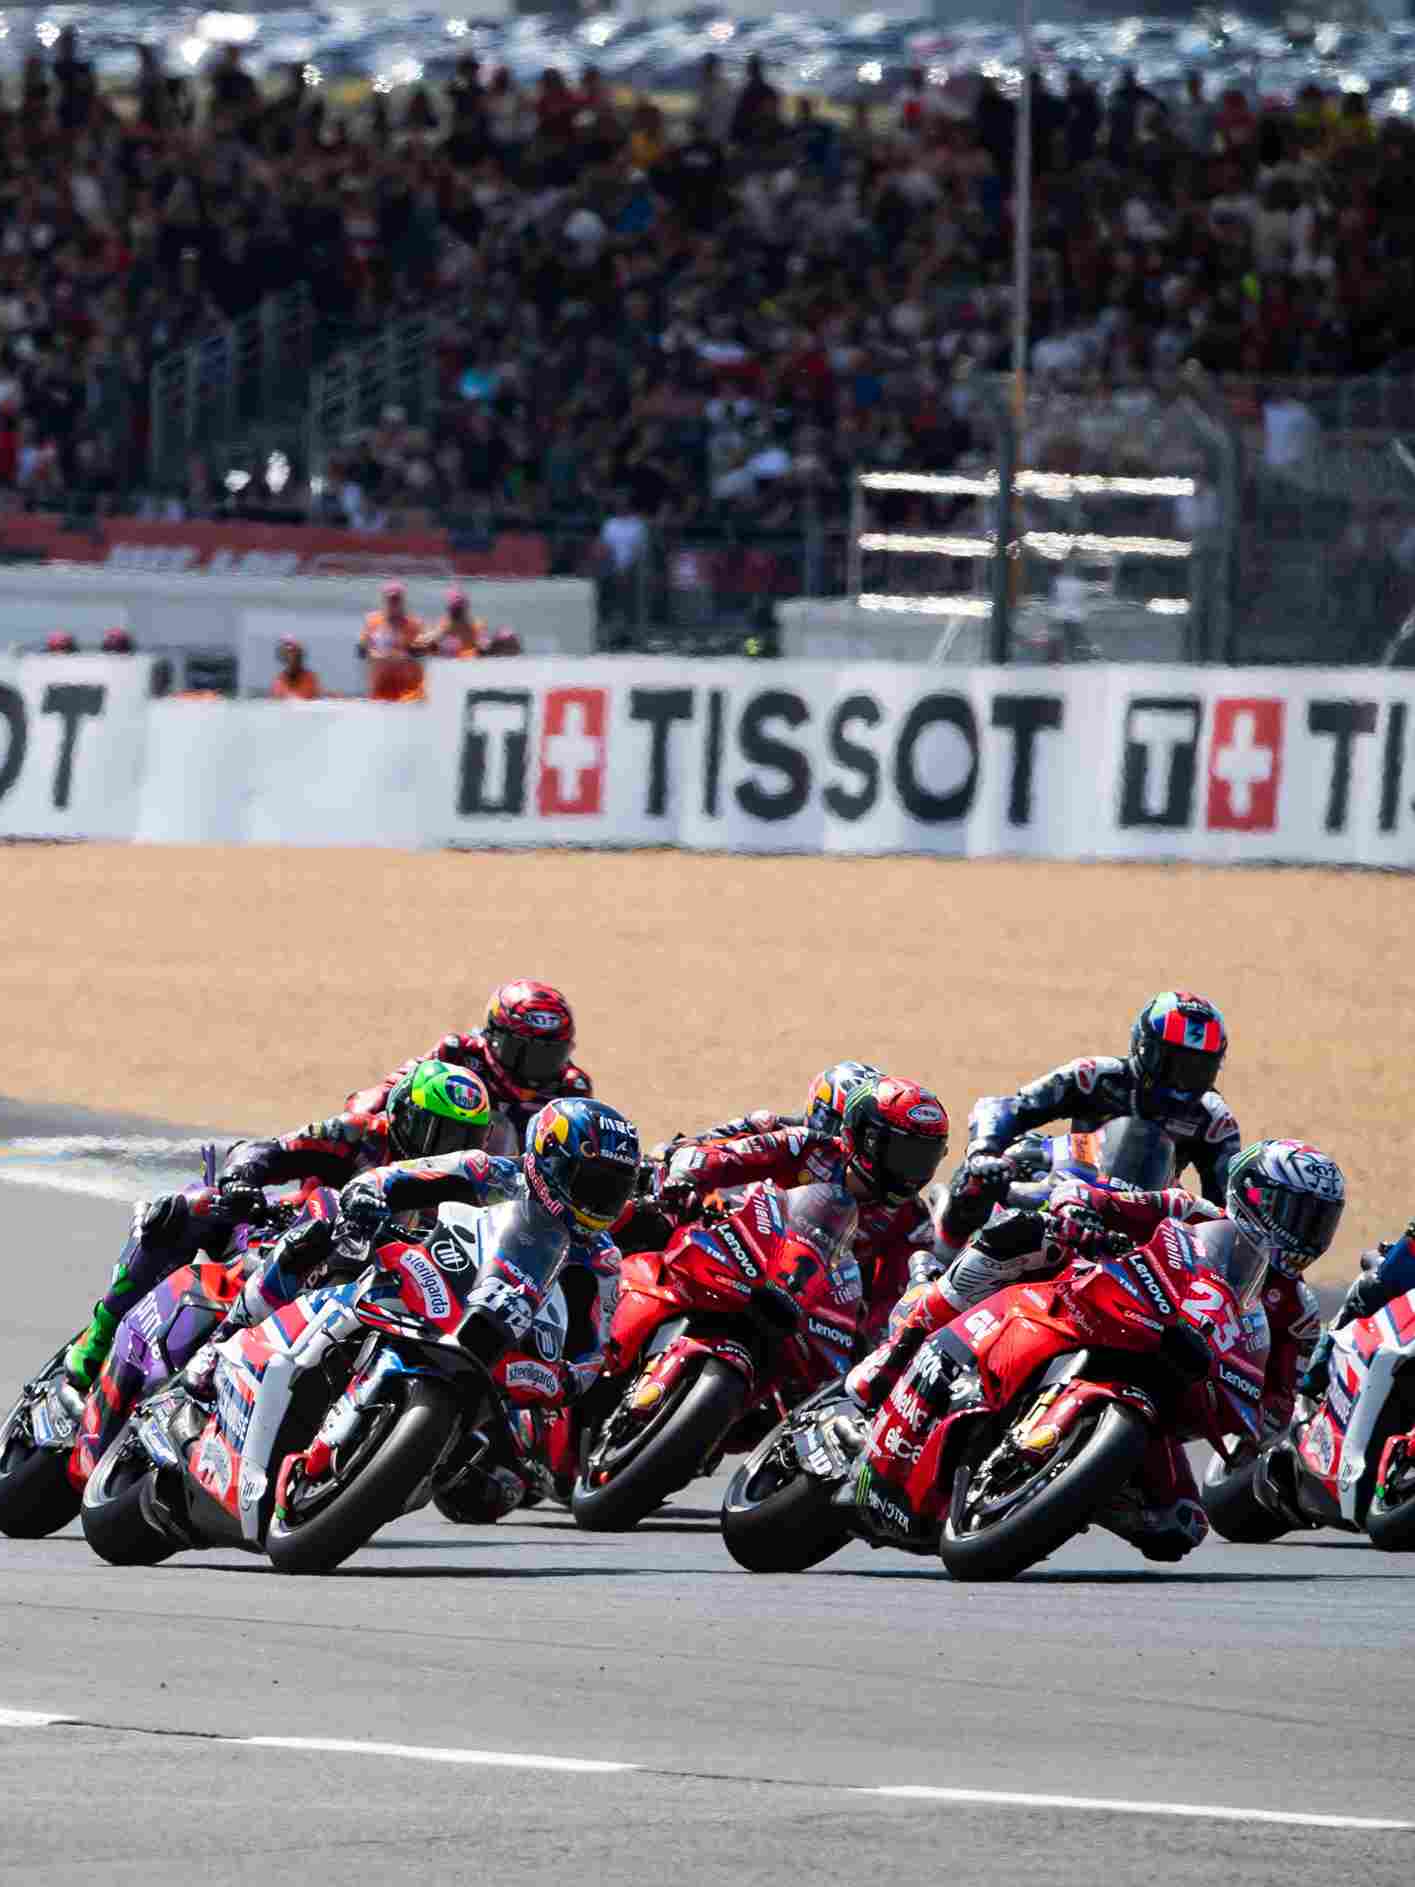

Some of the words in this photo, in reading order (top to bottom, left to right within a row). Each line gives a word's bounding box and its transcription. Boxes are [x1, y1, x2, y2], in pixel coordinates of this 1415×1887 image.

[630, 686, 1063, 827] TISSOT
[1307, 699, 1415, 835] TI
[716, 1222, 759, 1279] Lenovo
[404, 1252, 450, 1316] sterilgarda
[1128, 1254, 1172, 1315] Lenovo
[807, 1317, 854, 1348] Lenovo
[1219, 1363, 1262, 1400] Lenovo
